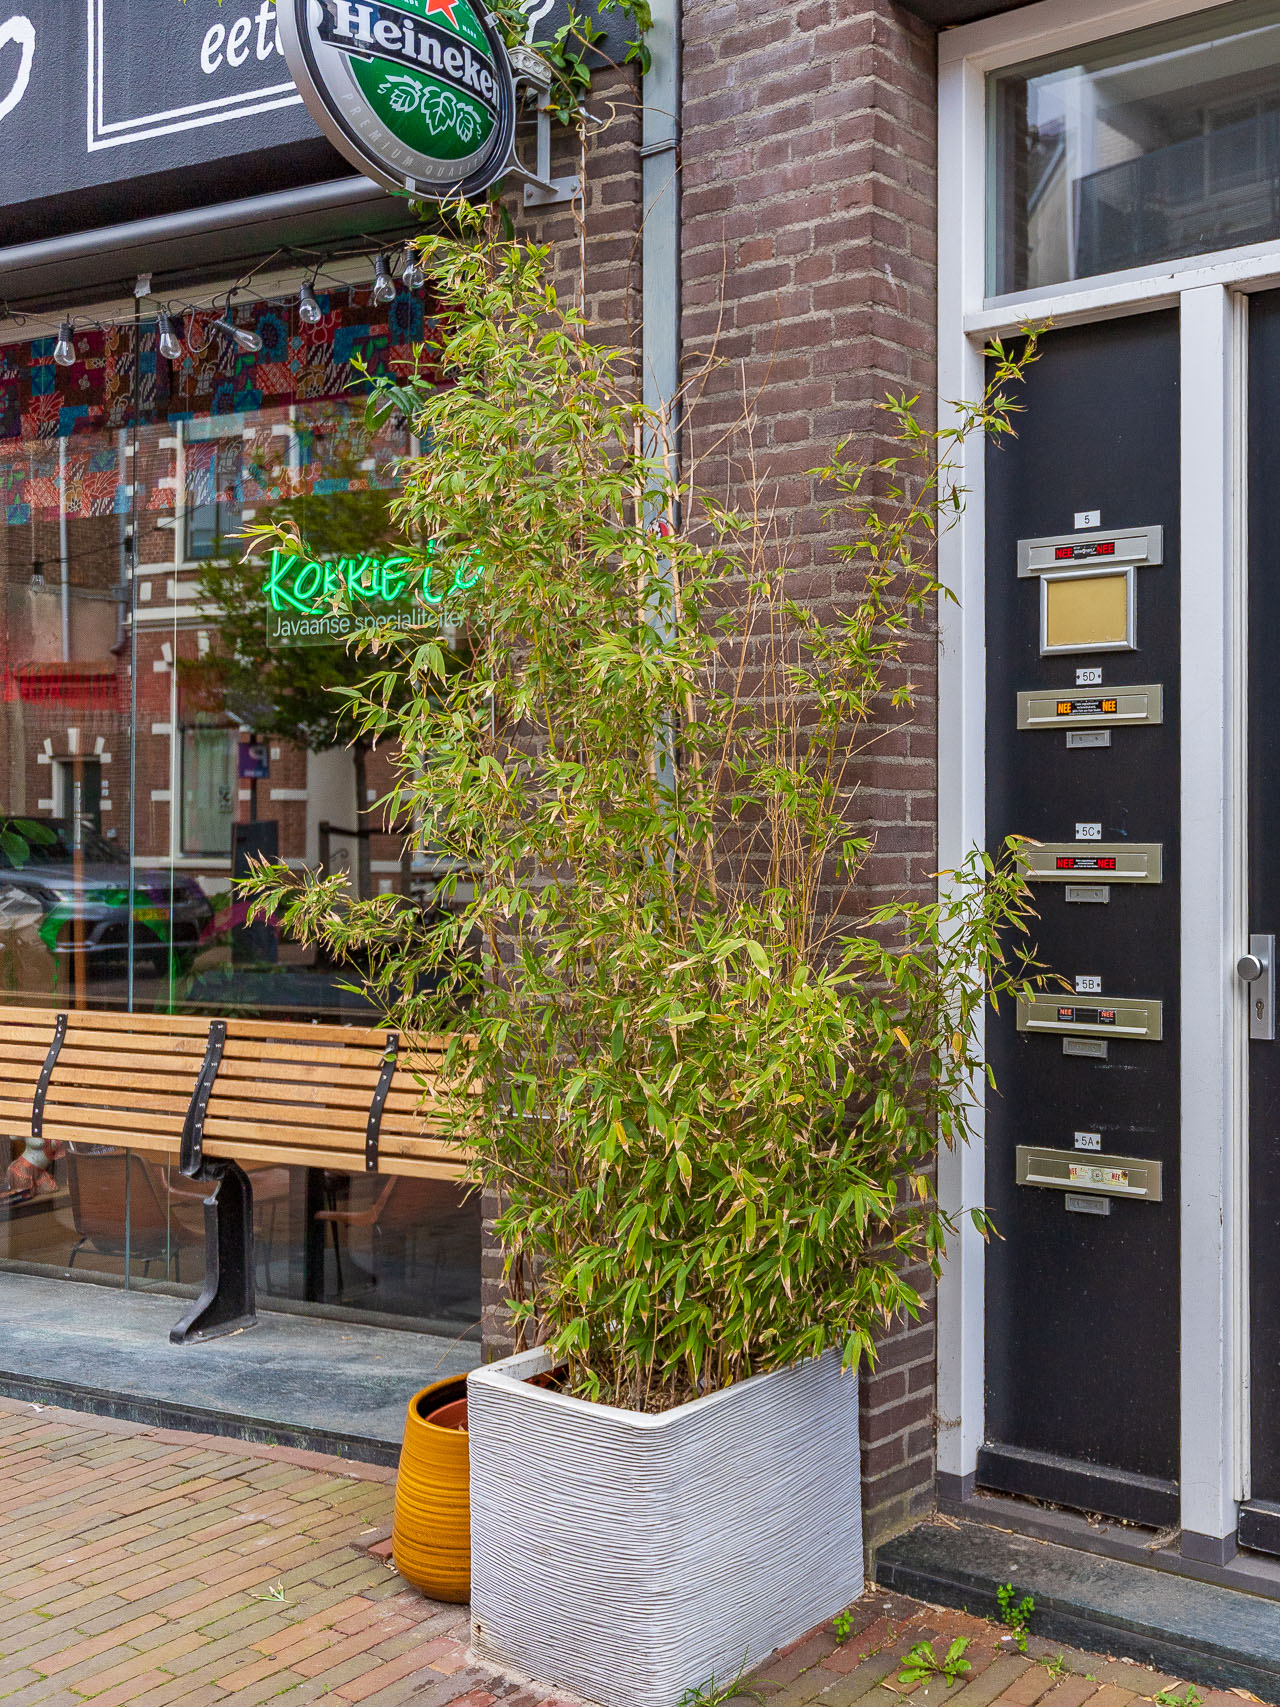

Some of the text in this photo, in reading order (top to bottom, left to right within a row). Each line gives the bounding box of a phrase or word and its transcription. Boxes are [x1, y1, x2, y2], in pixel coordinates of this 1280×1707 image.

[342, 92, 414, 168] PREMIUM
[1084, 514, 1091, 524] 5
[1056, 547, 1073, 559] NEE
[1096, 543, 1115, 555] NEE
[272, 616, 350, 637] Javaanse
[1082, 671, 1096, 682] 5D
[1057, 702, 1072, 714] NEE
[1102, 700, 1116, 712] NEE
[1082, 826, 1095, 837] 5C
[1056, 858, 1074, 868] NEE
[1097, 858, 1115, 869] NEE
[1082, 979, 1095, 989] 5B
[1059, 1008, 1114, 1018] NEE NEE
[1081, 1136, 1094, 1146] 5A
